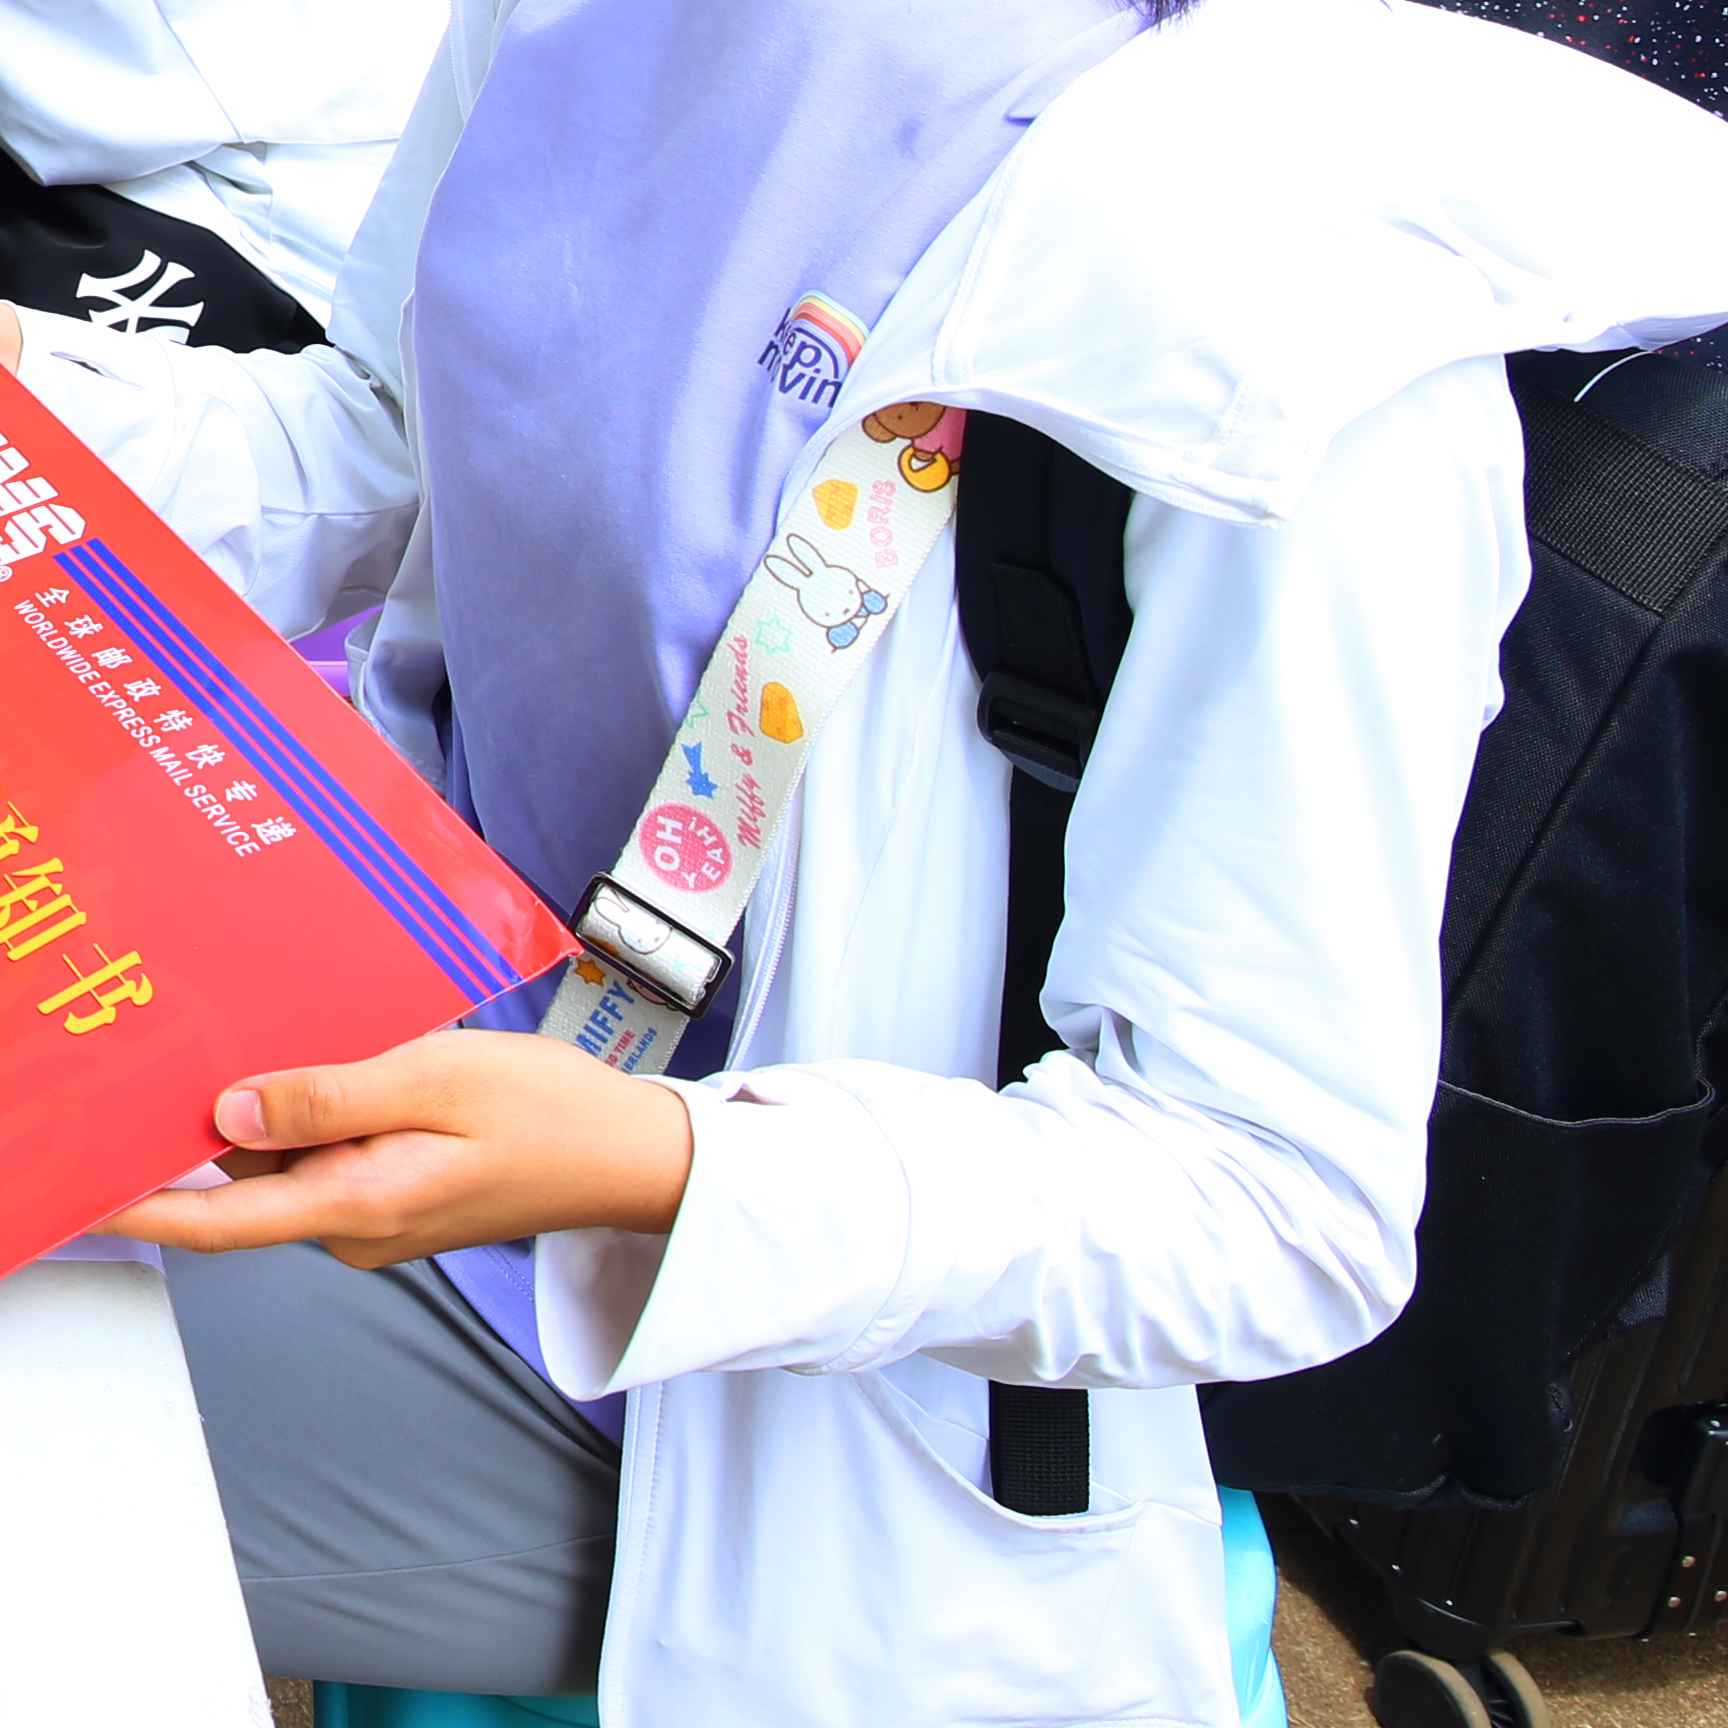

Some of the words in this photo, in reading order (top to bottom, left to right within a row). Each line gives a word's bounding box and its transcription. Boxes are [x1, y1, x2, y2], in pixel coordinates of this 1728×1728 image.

[874, 477, 900, 569] BORIS
[12, 597, 97, 692] WORLDWIDE
[89, 680, 154, 754] EXPRESS
[184, 784, 258, 858] SERVICE
[38, 583, 296, 853] 全球邮政特快专递
[727, 635, 751, 736] Friends
[729, 742, 754, 770] &
[654, 812, 684, 872] OH
[736, 774, 763, 852] Miffy
